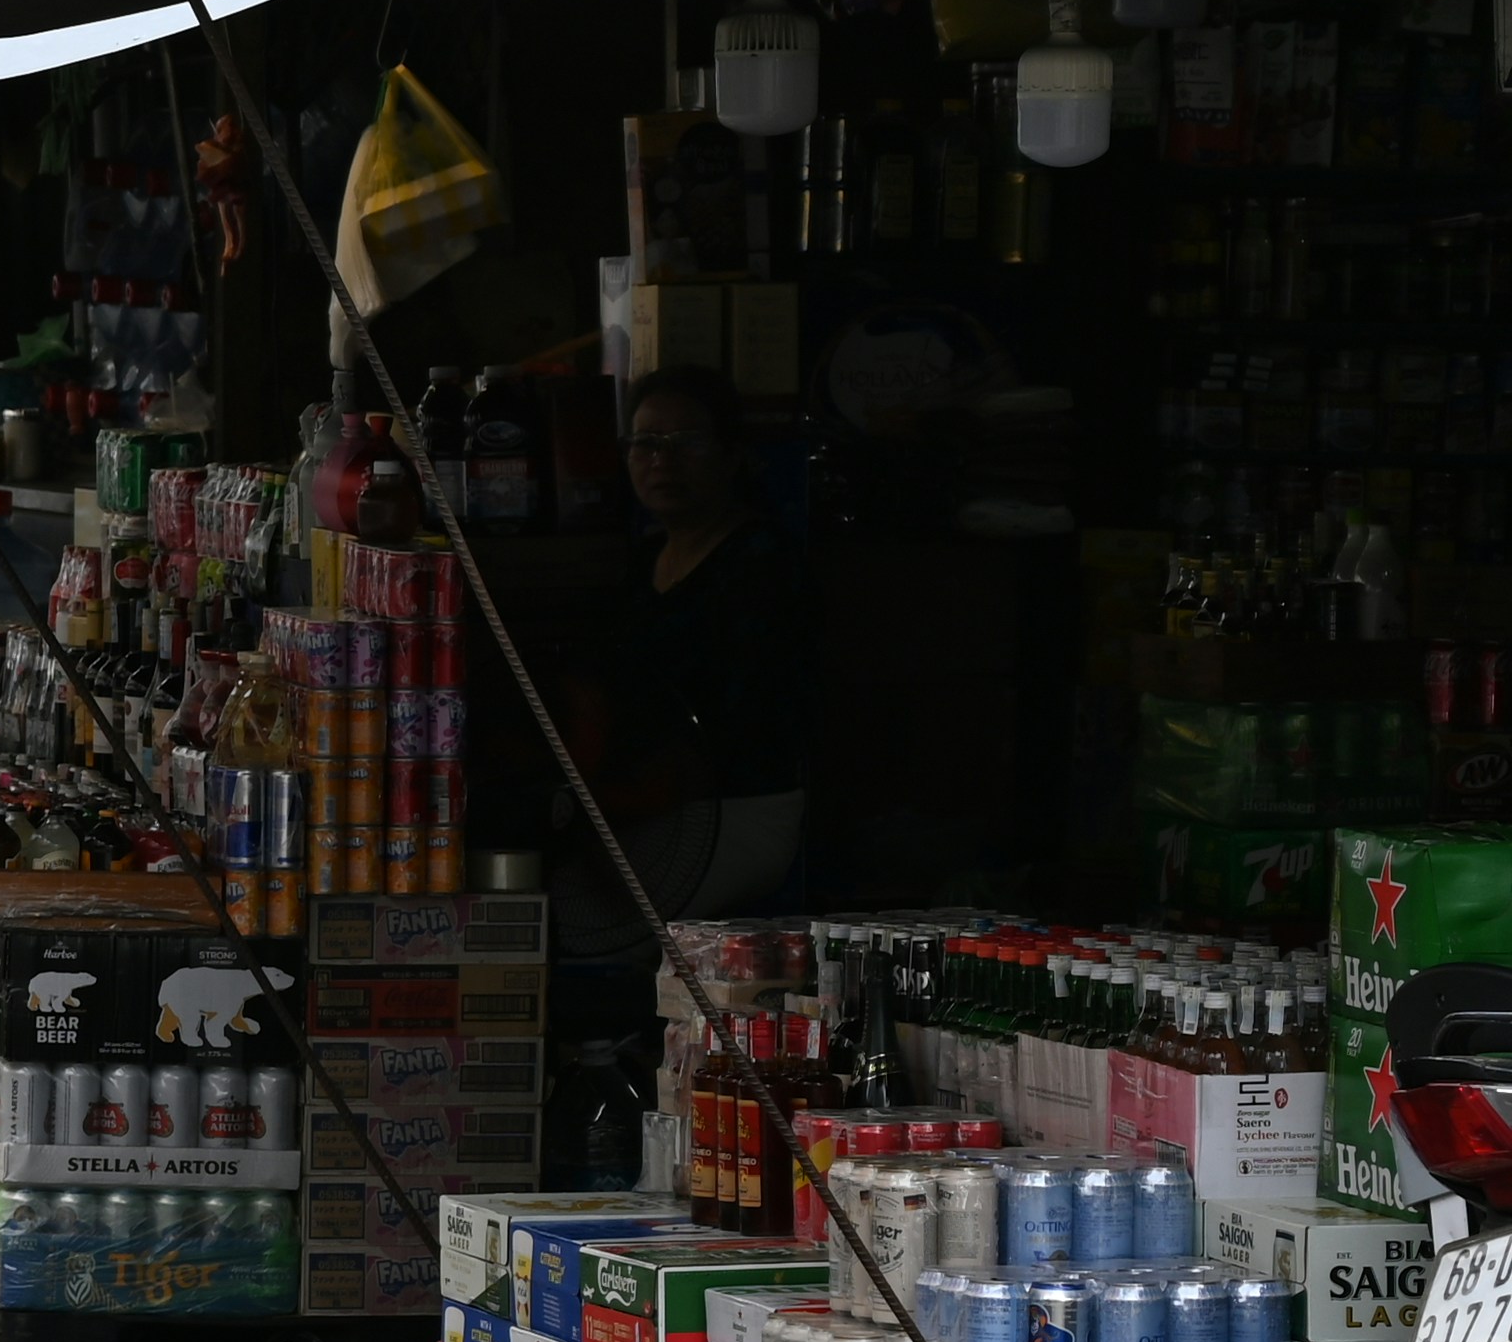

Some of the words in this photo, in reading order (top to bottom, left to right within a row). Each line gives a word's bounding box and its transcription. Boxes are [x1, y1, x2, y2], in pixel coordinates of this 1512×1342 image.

[1241, 796, 1316, 815] Heineken
[1347, 794, 1422, 812] ORIGINAL
[1351, 839, 1366, 859] 20
[199, 950, 238, 961] STRONG
[35, 1015, 80, 1030] BEAR
[36, 1030, 78, 1045] BEER
[1347, 1027, 1362, 1048] 20
[1236, 1117, 1271, 1128] Saero
[1237, 1129, 1280, 1142] Lychee
[1282, 1131, 1316, 1140] Flavour
[67, 1158, 140, 1174] STELLA
[164, 1159, 239, 1176] ARTOIS
[446, 1214, 473, 1238] SAIGON
[1231, 1212, 1243, 1227] BIA
[1218, 1222, 1255, 1251] SAIGON
[1221, 1244, 1250, 1264] LAGER
[108, 1251, 222, 1305] Tiger
[597, 1257, 638, 1299] Carlsberg
[1329, 1265, 1428, 1301] SAIG
[1345, 1304, 1418, 1328] LAG
